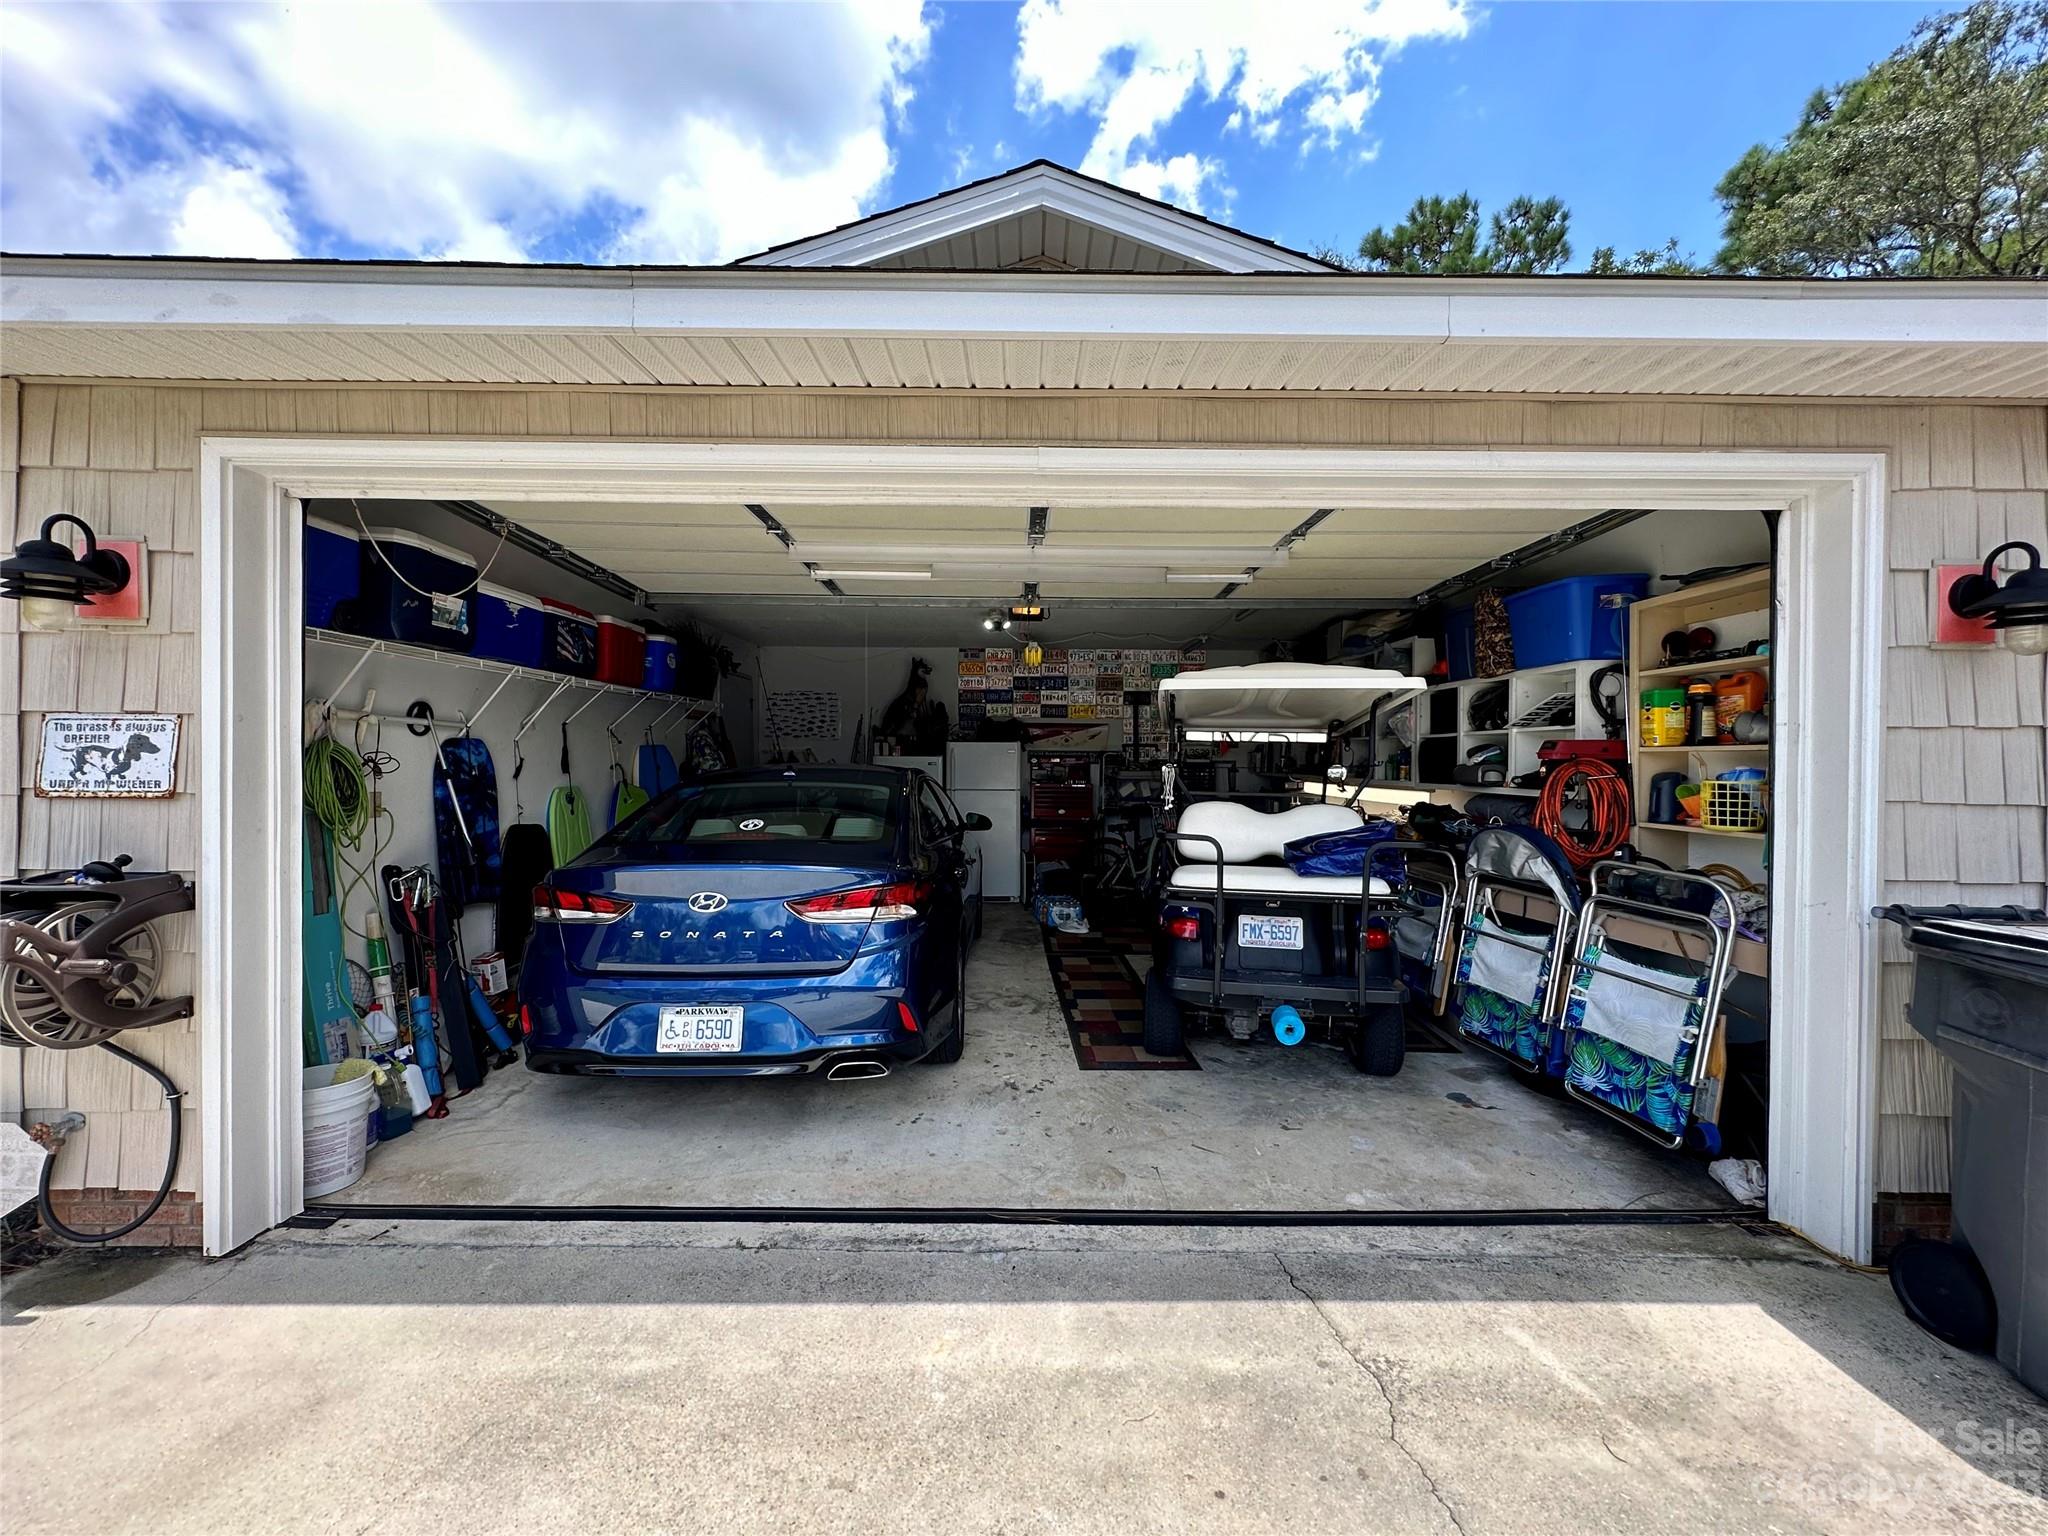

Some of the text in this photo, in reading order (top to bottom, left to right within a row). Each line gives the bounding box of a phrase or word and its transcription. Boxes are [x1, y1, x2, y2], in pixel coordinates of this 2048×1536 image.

[1511, 695, 1575, 727] GARAGE
[54, 722, 72, 732] The
[76, 722, 108, 733] grass
[125, 721, 167, 733] always
[64, 734, 110, 743] GREENER
[115, 779, 162, 789] WIENER
[631, 930, 784, 940] SONATA
[1242, 923, 1299, 941] FMX-6597
[324, 982, 335, 1011] Thrive
[679, 1007, 725, 1016] PARKWAY
